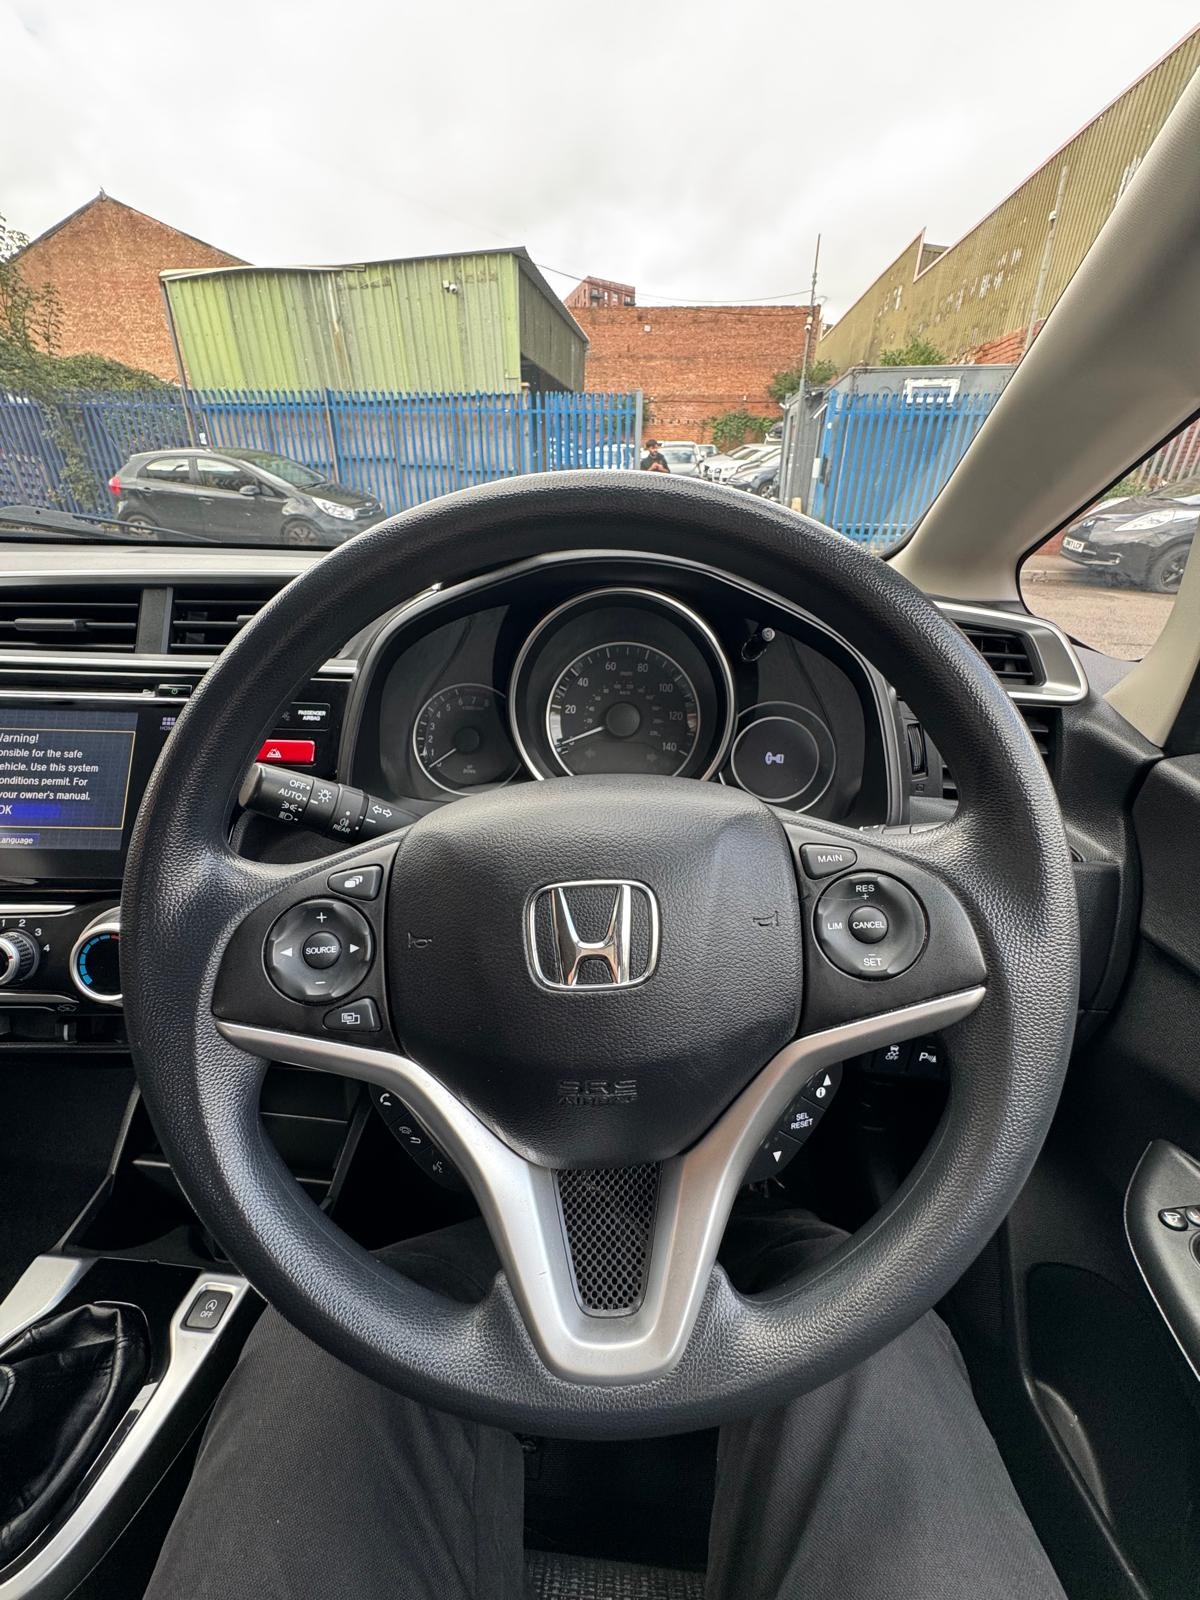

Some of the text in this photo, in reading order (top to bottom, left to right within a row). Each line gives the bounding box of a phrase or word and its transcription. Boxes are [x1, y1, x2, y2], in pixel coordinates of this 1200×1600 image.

[605, 662, 616, 671] 60
[638, 662, 649, 672] 80
[577, 677, 588, 687] 40
[659, 683, 673, 692] 100
[565, 704, 576, 714] 20
[669, 711, 683, 720] 120
[662, 742, 677, 751] 140
[32, 749, 44, 758] for
[47, 749, 62, 758] the
[64, 750, 83, 758] safe
[30, 762, 47, 771] Use
[50, 763, 66, 771] this
[68, 764, 98, 773] system
[41, 777, 70, 786] permit.
[73, 778, 88, 786] For
[290, 780, 306, 790] OFF
[20, 791, 54, 800] owner's
[56, 792, 90, 800] manual.
[278, 788, 302, 801] AUTO
[333, 824, 350, 833] REAR
[818, 854, 843, 863] MAIN
[856, 884, 874, 893] RES
[852, 921, 884, 930] CANCEL
[35, 928, 42, 936] 3
[43, 944, 50, 952] 4
[306, 946, 336, 955] SOURCE
[863, 958, 882, 966] SET
[560, 1080, 637, 1096] SRS
[796, 1112, 809, 1121] SEL
[790, 1118, 813, 1130] RESET
